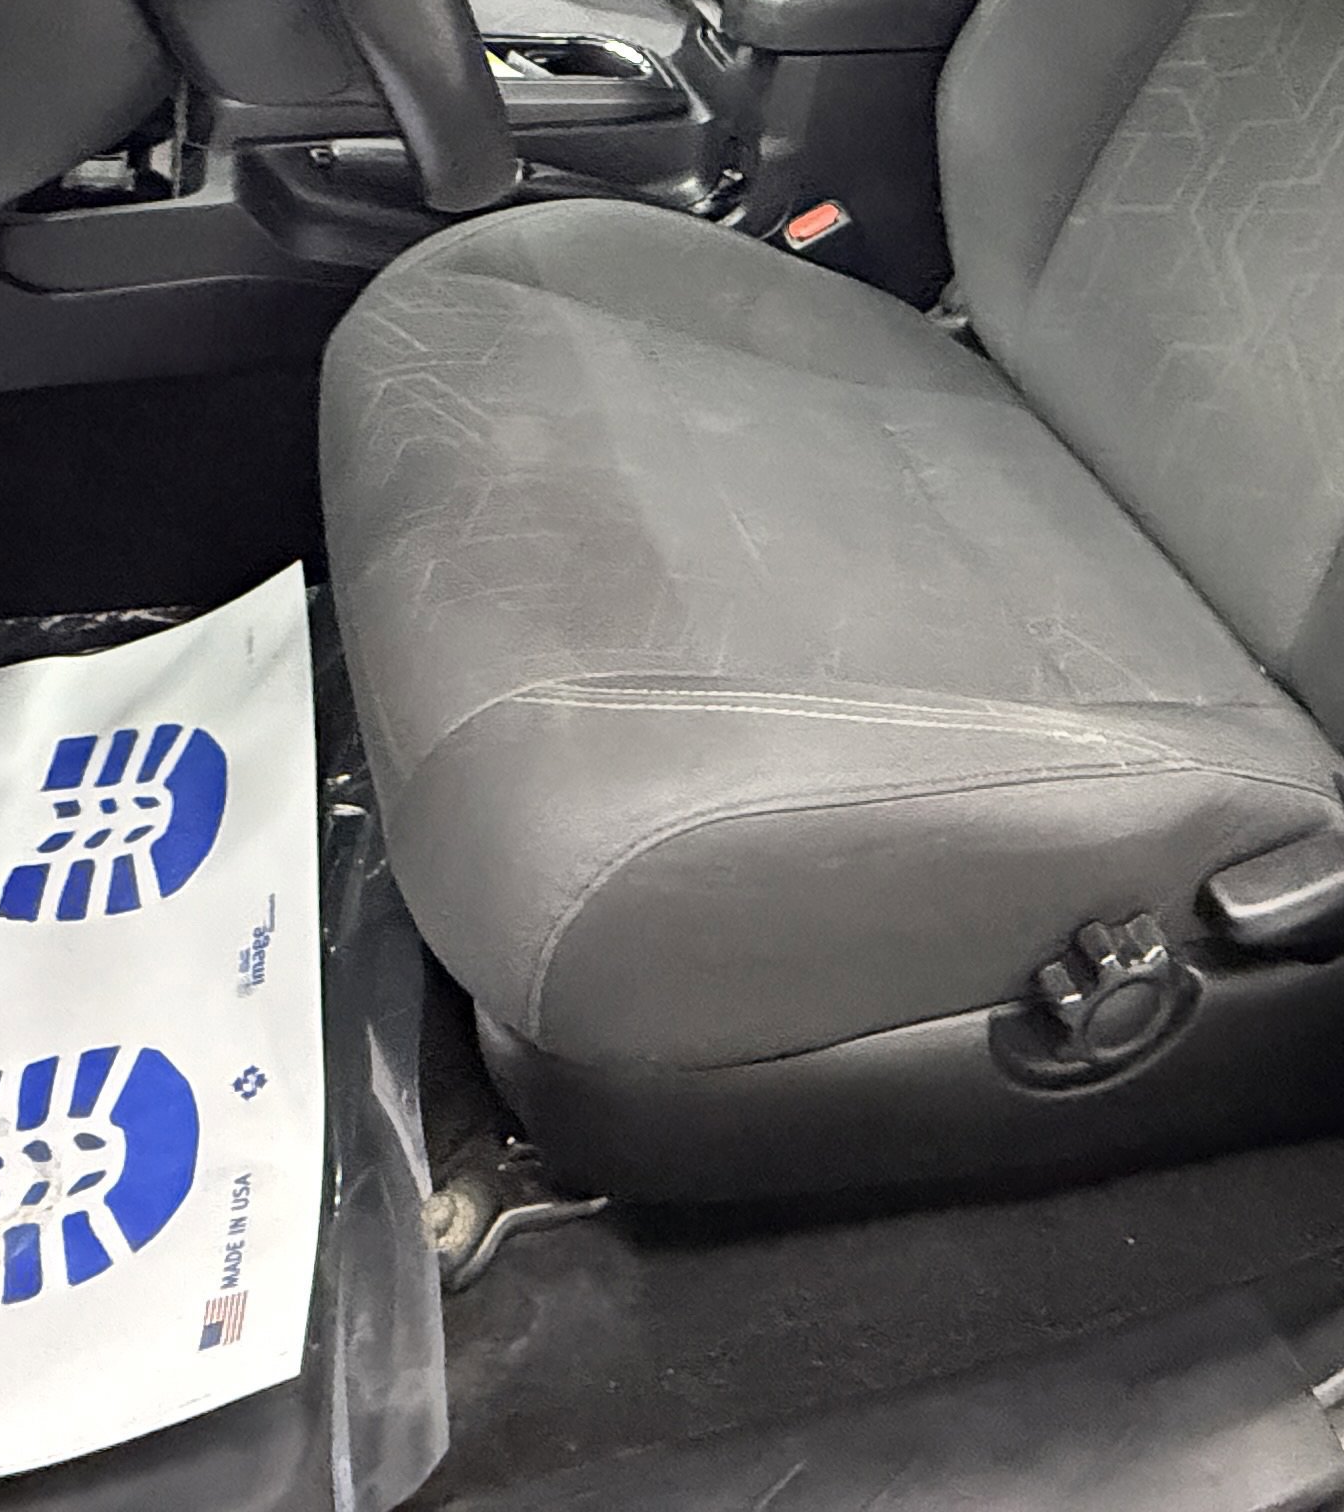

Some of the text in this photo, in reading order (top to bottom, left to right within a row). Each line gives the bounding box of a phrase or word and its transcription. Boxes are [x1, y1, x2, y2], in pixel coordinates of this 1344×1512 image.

[220, 1172, 250, 1289] MADE IN USA
